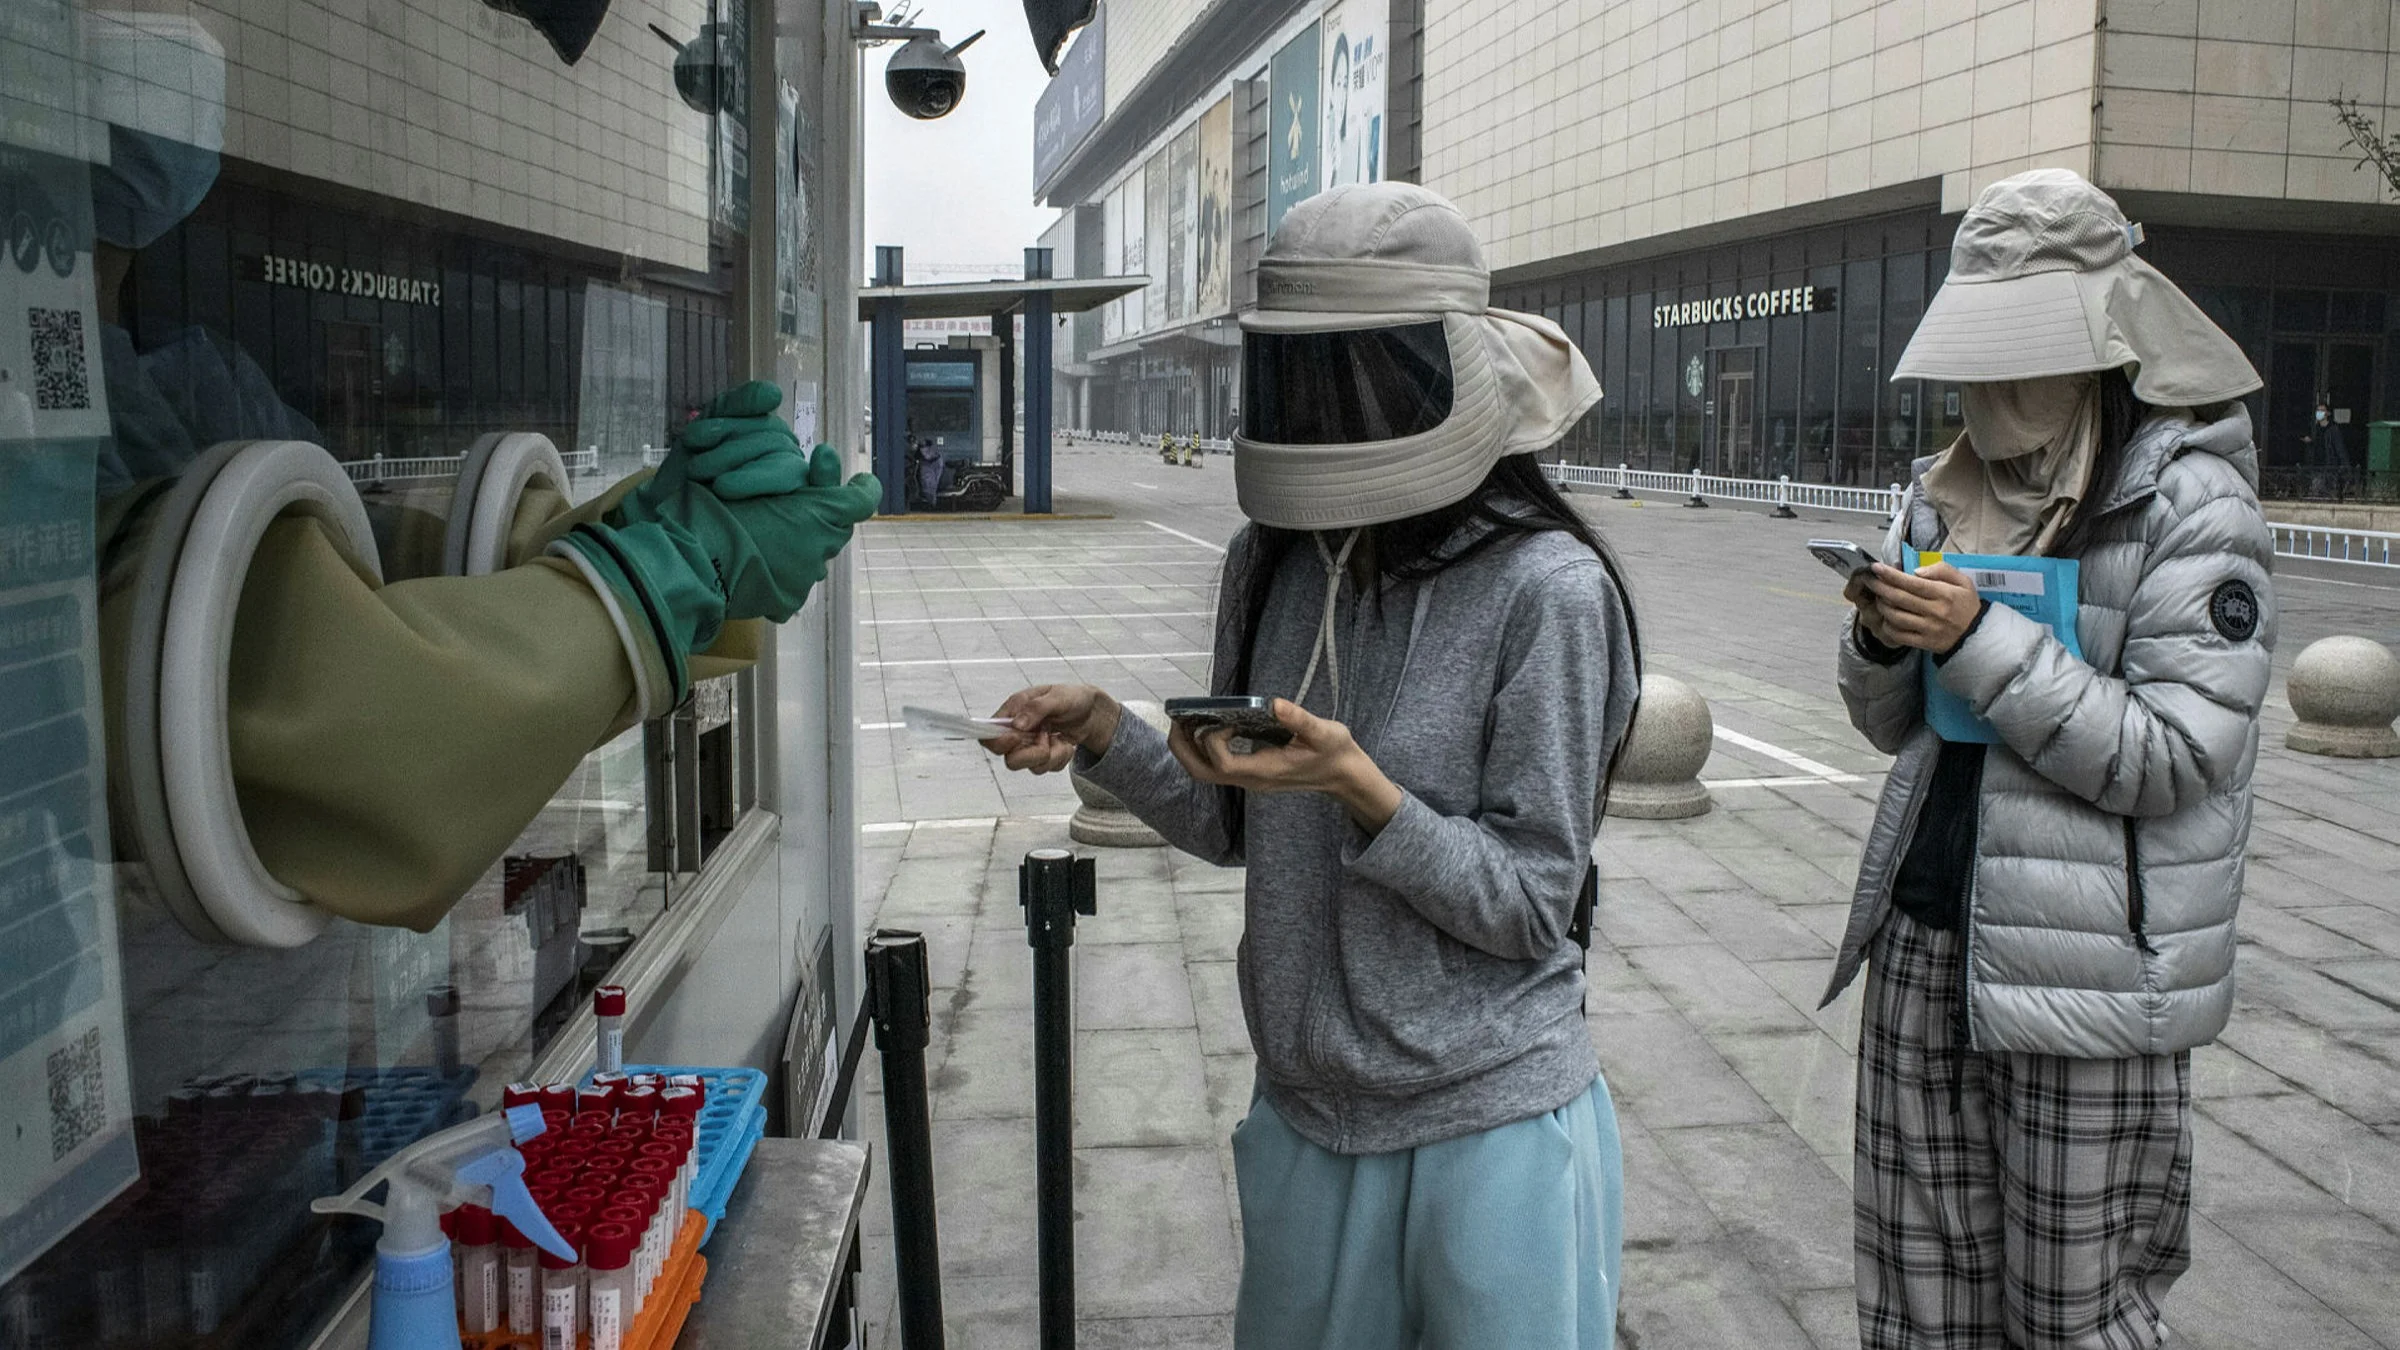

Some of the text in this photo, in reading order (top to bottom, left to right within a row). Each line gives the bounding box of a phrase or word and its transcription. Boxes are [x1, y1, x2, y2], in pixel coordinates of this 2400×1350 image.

[1280, 162, 1309, 194] hotwind
[1654, 285, 1814, 328] STARBUCKS COFFEE
